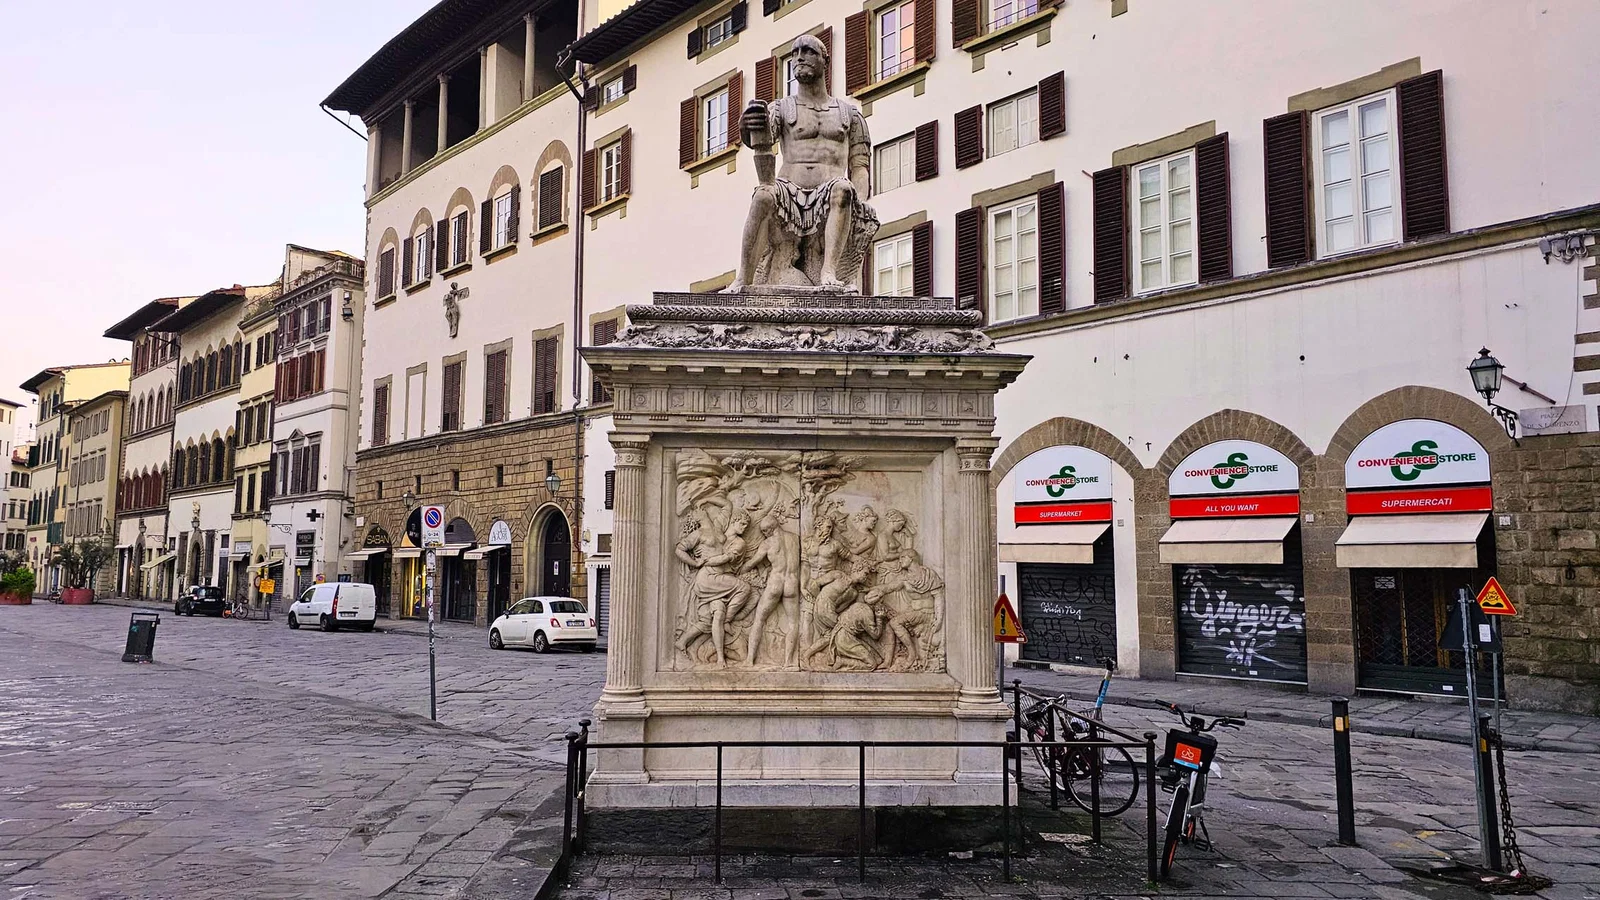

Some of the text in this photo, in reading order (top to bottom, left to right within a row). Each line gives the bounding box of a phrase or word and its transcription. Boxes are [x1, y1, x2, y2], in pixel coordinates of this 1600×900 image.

[1358, 453, 1476, 468] CONVENIENCE STORE
[1184, 464, 1278, 477] CONVENIENCE STORE
[1025, 478, 1075, 486] CONVENIENCE
[1381, 497, 1452, 508] SUPERMERCATI
[1039, 510, 1083, 518] SUPERMARKET
